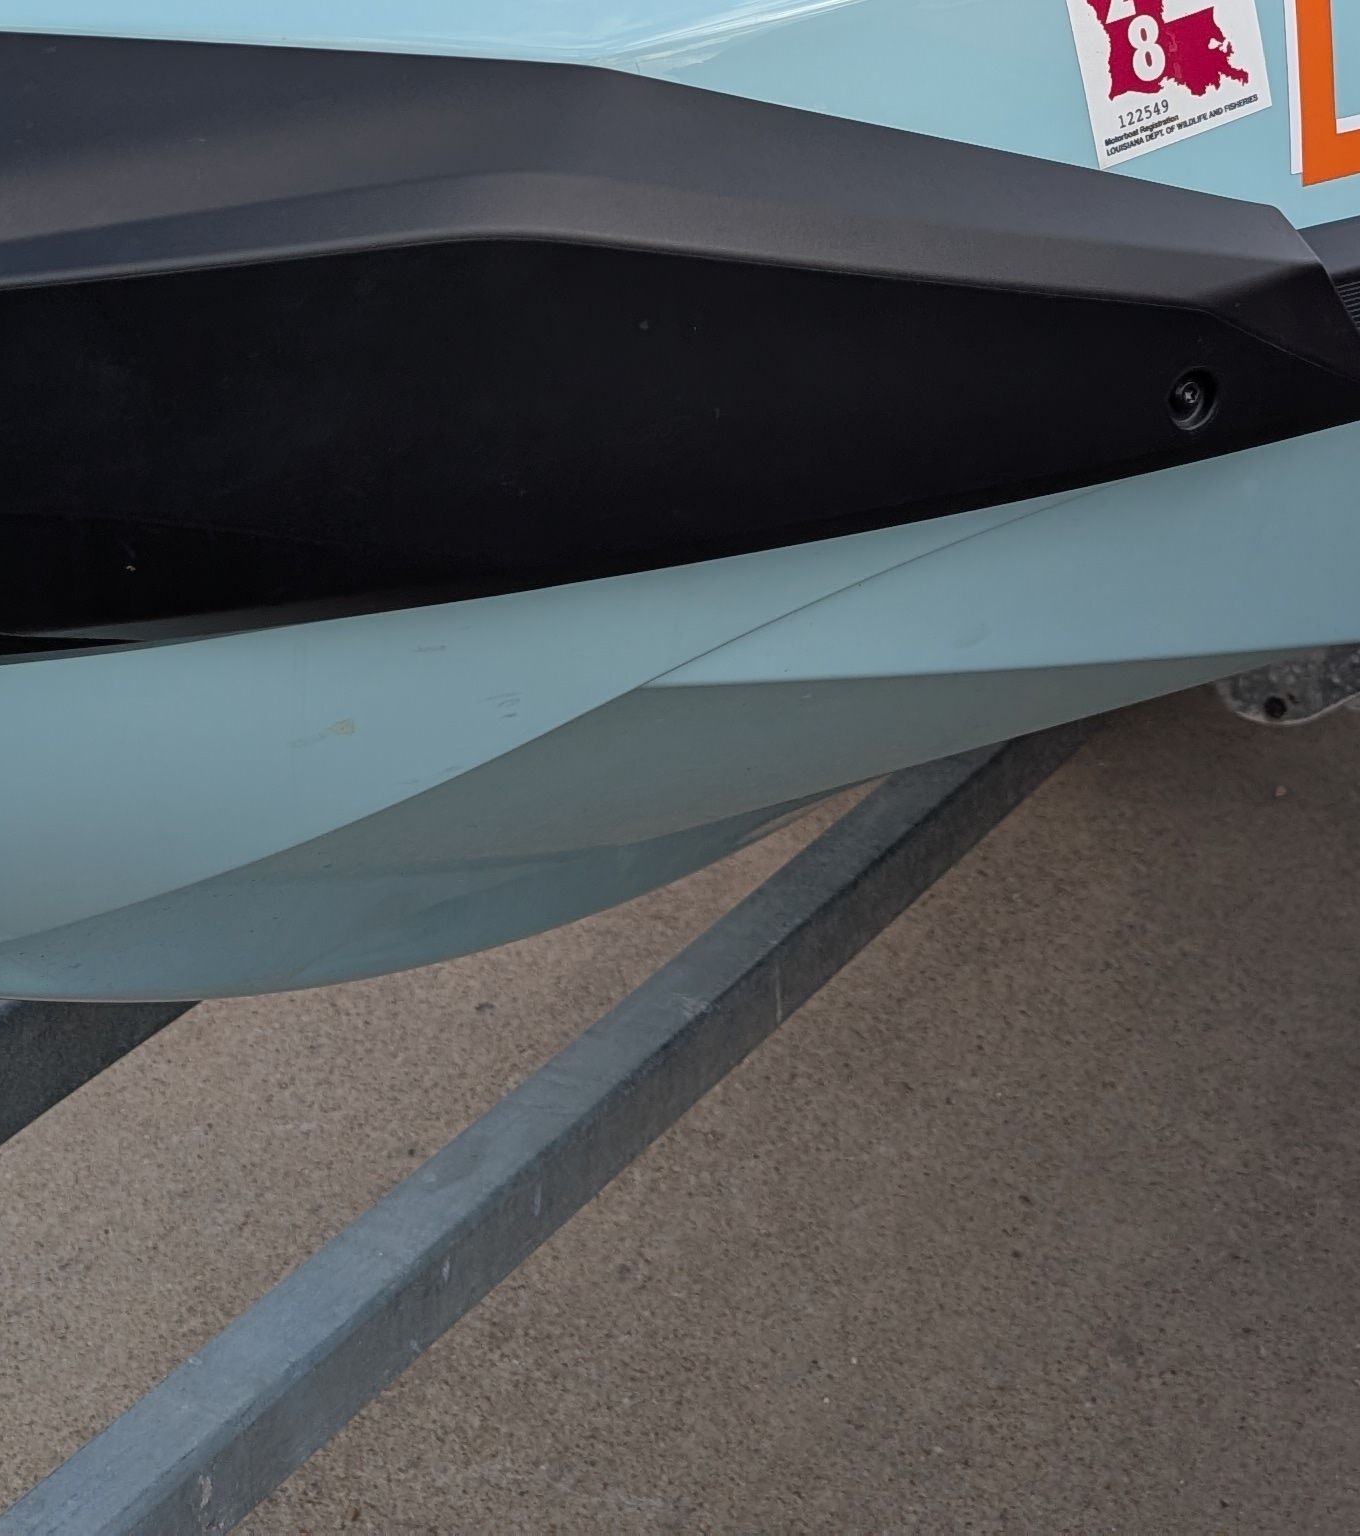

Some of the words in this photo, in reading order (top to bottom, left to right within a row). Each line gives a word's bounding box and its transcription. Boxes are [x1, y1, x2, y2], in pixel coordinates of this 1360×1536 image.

[1106, 136, 1145, 156] LOUISIANA
[1165, 125, 1175, 134] OF
[1176, 113, 1208, 131] WILDLIFE
[1209, 107, 1224, 118] AND
[1224, 93, 1259, 113] FISHERIES
[1118, 98, 1170, 129] 122549
[1105, 128, 1139, 147] Motorboat
[1140, 114, 1179, 133] Registration
